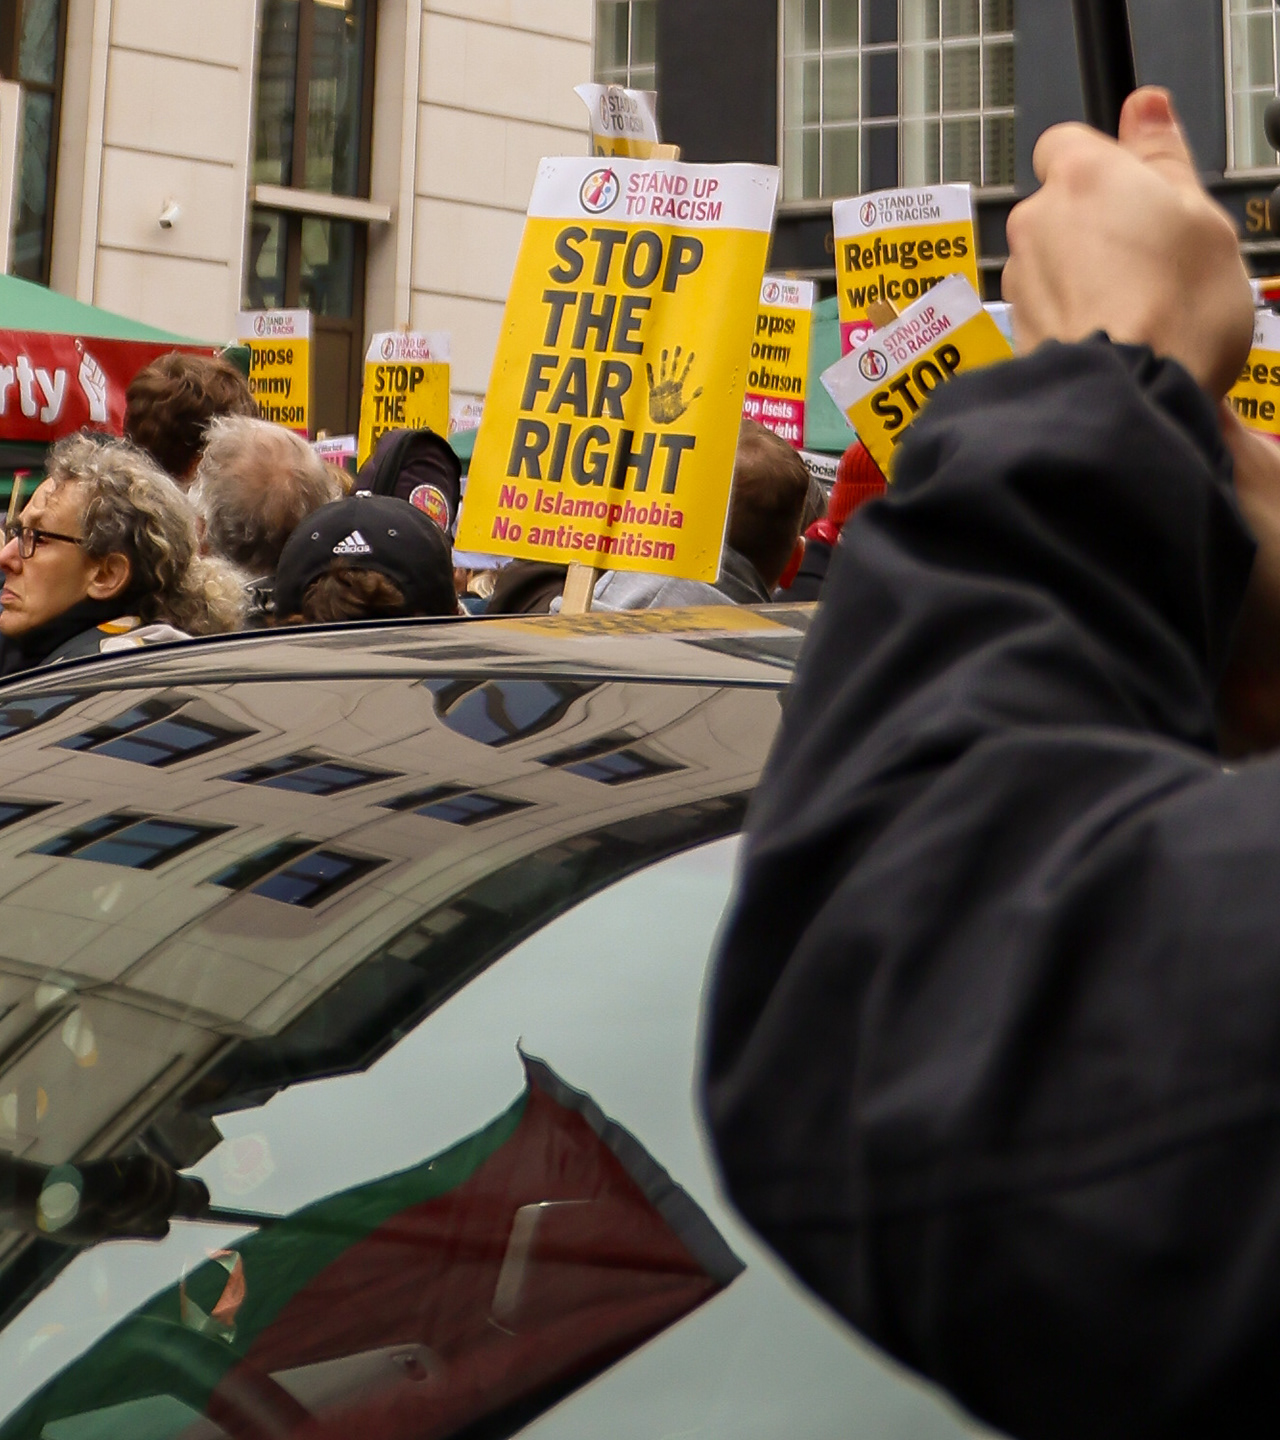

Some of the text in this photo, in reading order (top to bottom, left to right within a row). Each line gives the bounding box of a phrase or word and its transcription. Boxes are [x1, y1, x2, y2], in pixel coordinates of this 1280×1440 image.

[627, 173, 719, 198] STAND UP
[626, 196, 723, 222] TO RACISM
[878, 193, 933, 211] STAND UP
[879, 205, 941, 223] TO RACISM
[548, 226, 704, 293] STOP
[844, 234, 968, 273] Refugees
[847, 273, 946, 309] welcom
[541, 290, 652, 355] THE
[883, 317, 921, 353] STAND
[920, 306, 936, 326] UP
[401, 349, 429, 359] RACISM
[891, 345, 908, 365] TO
[907, 315, 952, 355] RACISM
[250, 375, 292, 399] ommy
[374, 365, 424, 392] STOP
[520, 353, 633, 420] FAR
[871, 343, 961, 430] STOP
[259, 400, 304, 424] binson
[373, 395, 407, 423] THE
[506, 419, 696, 494] RIGHT
[804, 459, 837, 478] Social
[498, 484, 684, 529] No Islamophobia
[333, 544, 371, 554] adidas
[491, 516, 676, 561] No antisemitism
